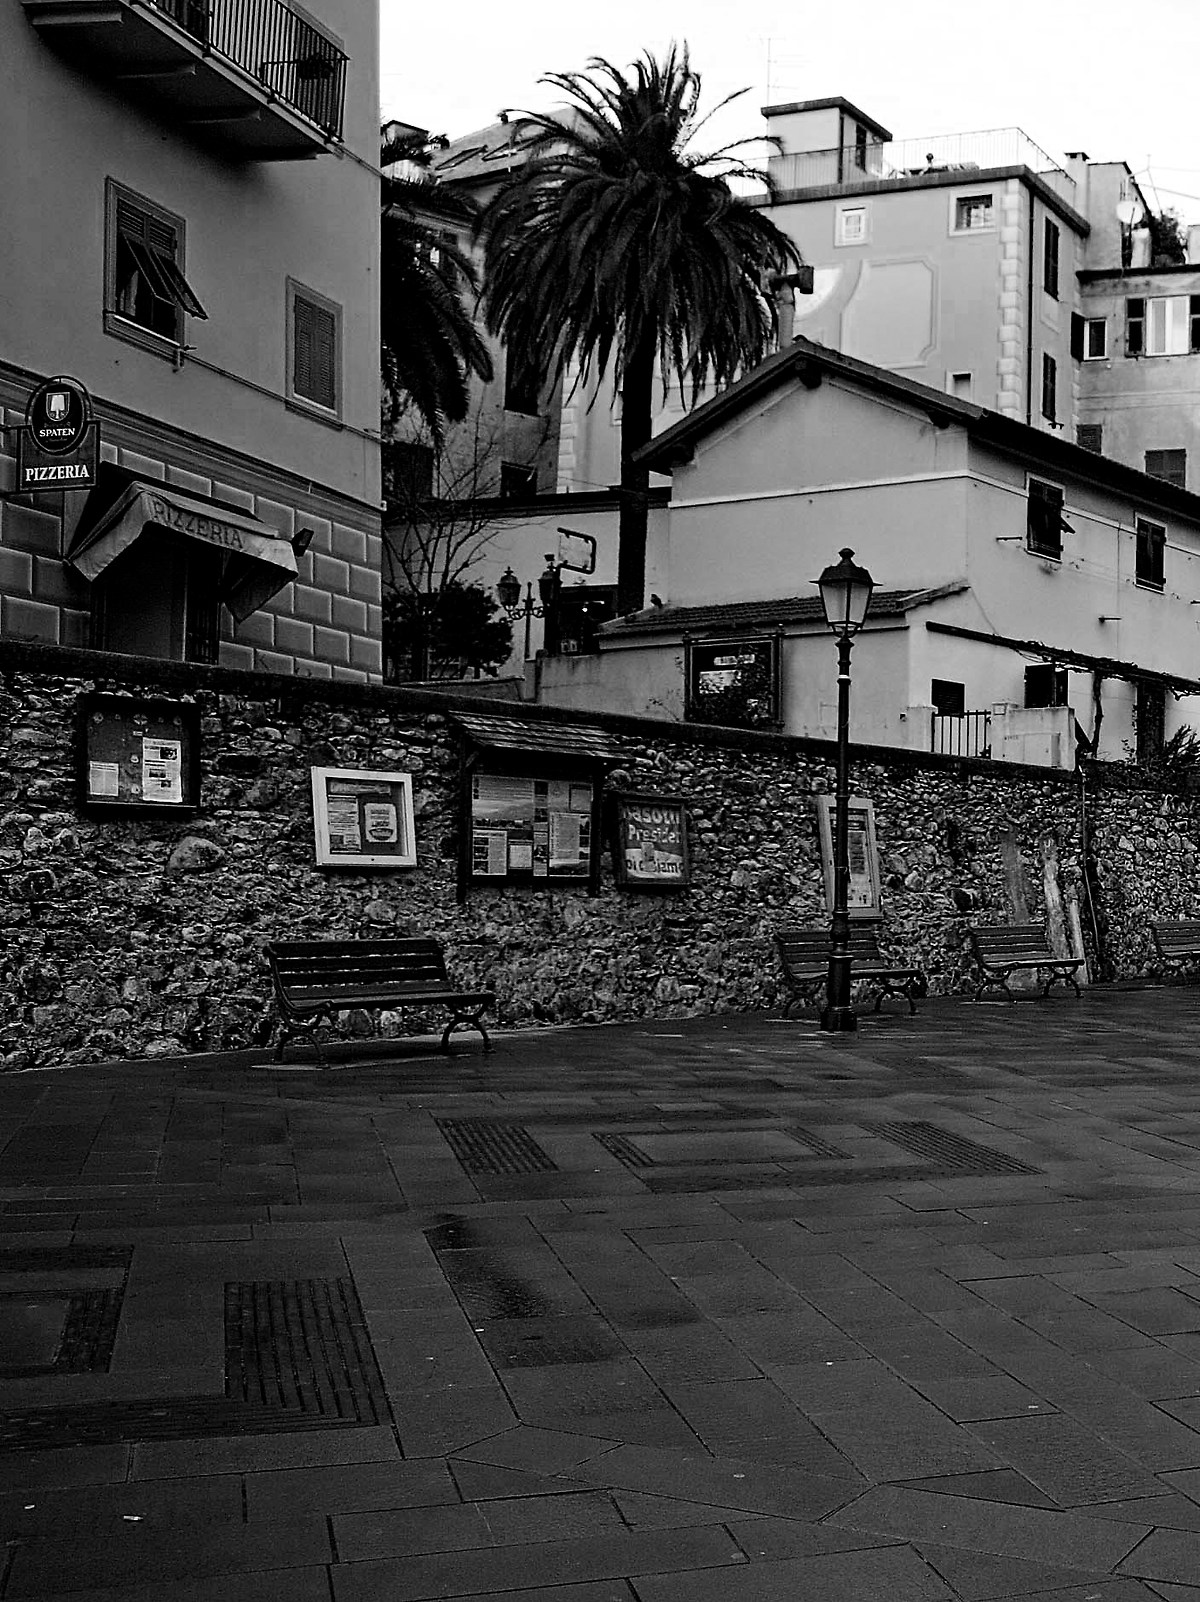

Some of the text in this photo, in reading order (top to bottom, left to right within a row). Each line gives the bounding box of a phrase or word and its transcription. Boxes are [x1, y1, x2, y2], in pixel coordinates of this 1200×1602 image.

[39, 427, 76, 438] SPATEN
[25, 464, 91, 482] PIZZERIA
[152, 500, 244, 549] PIZZERIA
